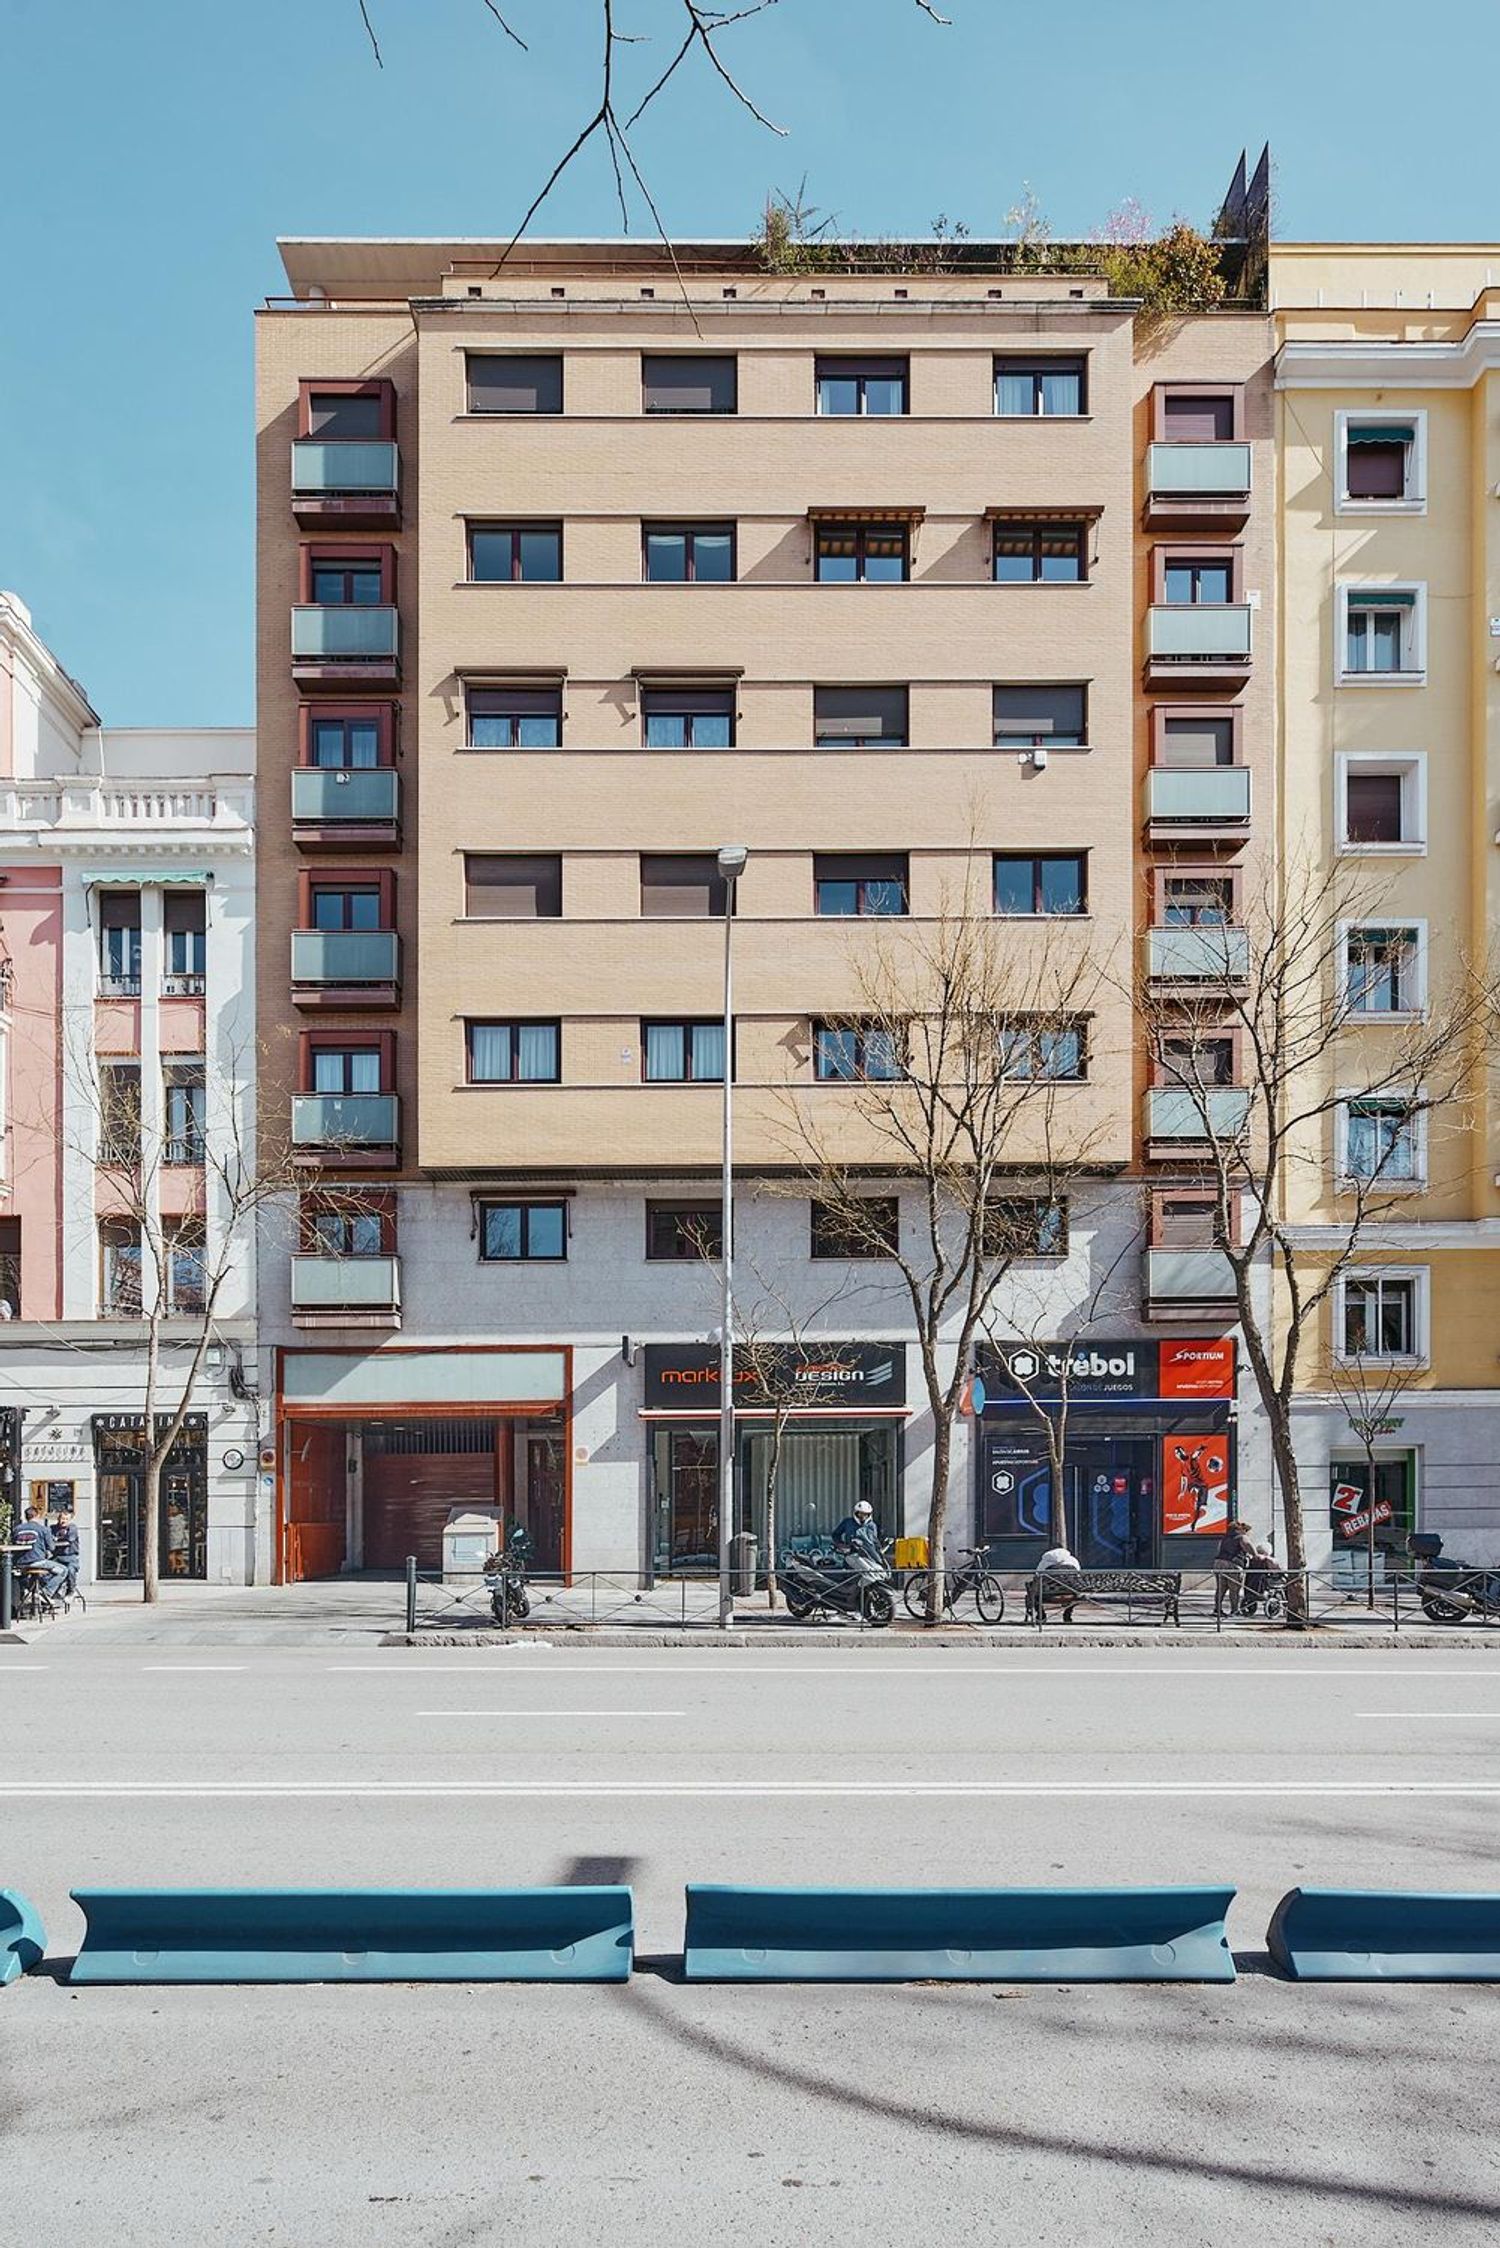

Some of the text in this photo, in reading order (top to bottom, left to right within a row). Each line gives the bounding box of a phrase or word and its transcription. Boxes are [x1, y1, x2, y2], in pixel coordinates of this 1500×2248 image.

[1168, 1347, 1224, 1362] SPORTIUM
[661, 1367, 759, 1383] markux
[109, 1415, 184, 1429] CATAIN
